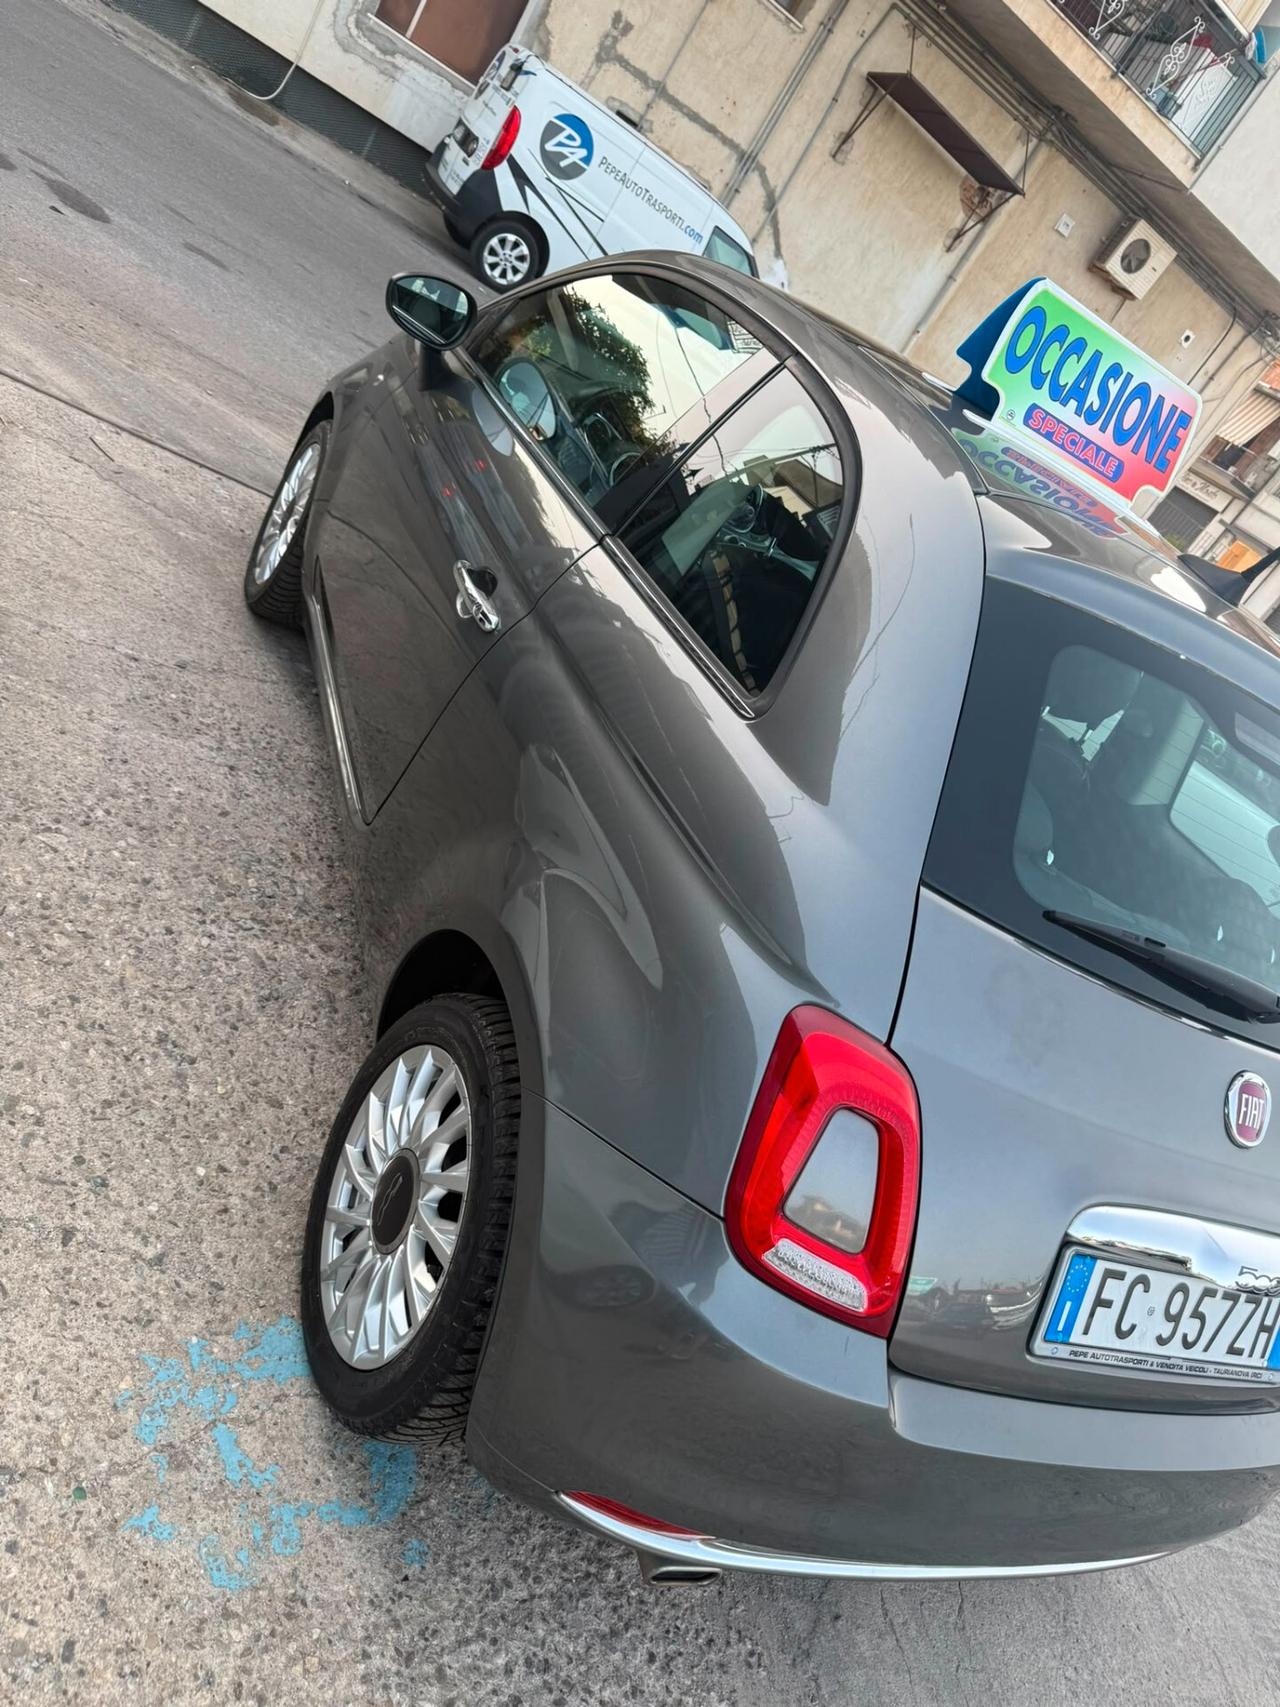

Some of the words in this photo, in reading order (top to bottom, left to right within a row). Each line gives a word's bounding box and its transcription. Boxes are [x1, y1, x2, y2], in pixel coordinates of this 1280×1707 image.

[1004, 305, 1193, 474] OCCASIONE
[1028, 408, 1119, 477] SPECIALE
[1238, 1092, 1265, 1130] FIAT
[1082, 1267, 1152, 1341] FC
[1155, 1281, 1280, 1360] 957ZH
[1068, 1349, 1089, 1359] PEPE
[1089, 1350, 1149, 1367] AUTOTRASPORTI
[1155, 1360, 1184, 1371] VENDITA
[1185, 1364, 1209, 1374] VEICOLI
[1213, 1367, 1251, 1378] TAURIANOVA
